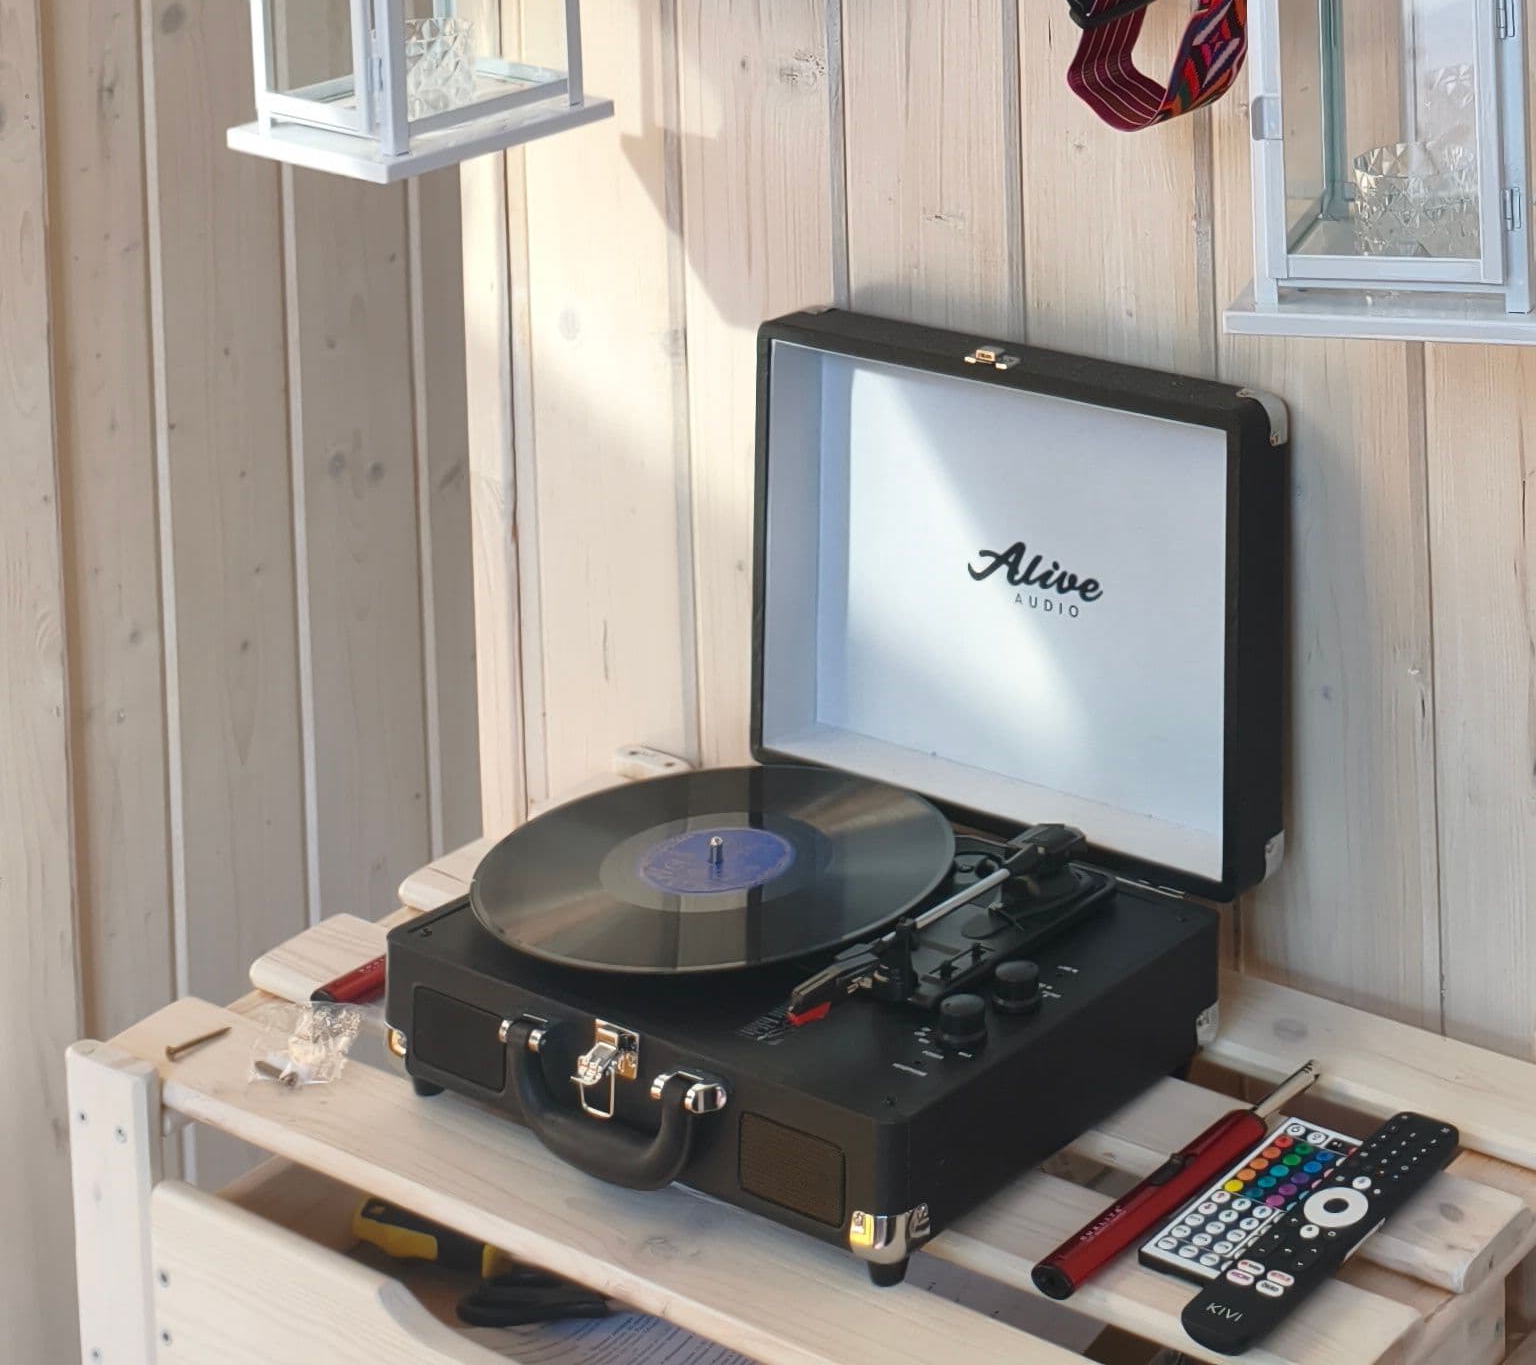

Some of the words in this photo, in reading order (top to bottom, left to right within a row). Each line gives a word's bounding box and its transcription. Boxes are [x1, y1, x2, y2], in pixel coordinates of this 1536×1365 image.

[967, 541, 1103, 602] Alive
[1014, 593, 1079, 618] AUDIO
[1206, 1302, 1244, 1322] KIVI
